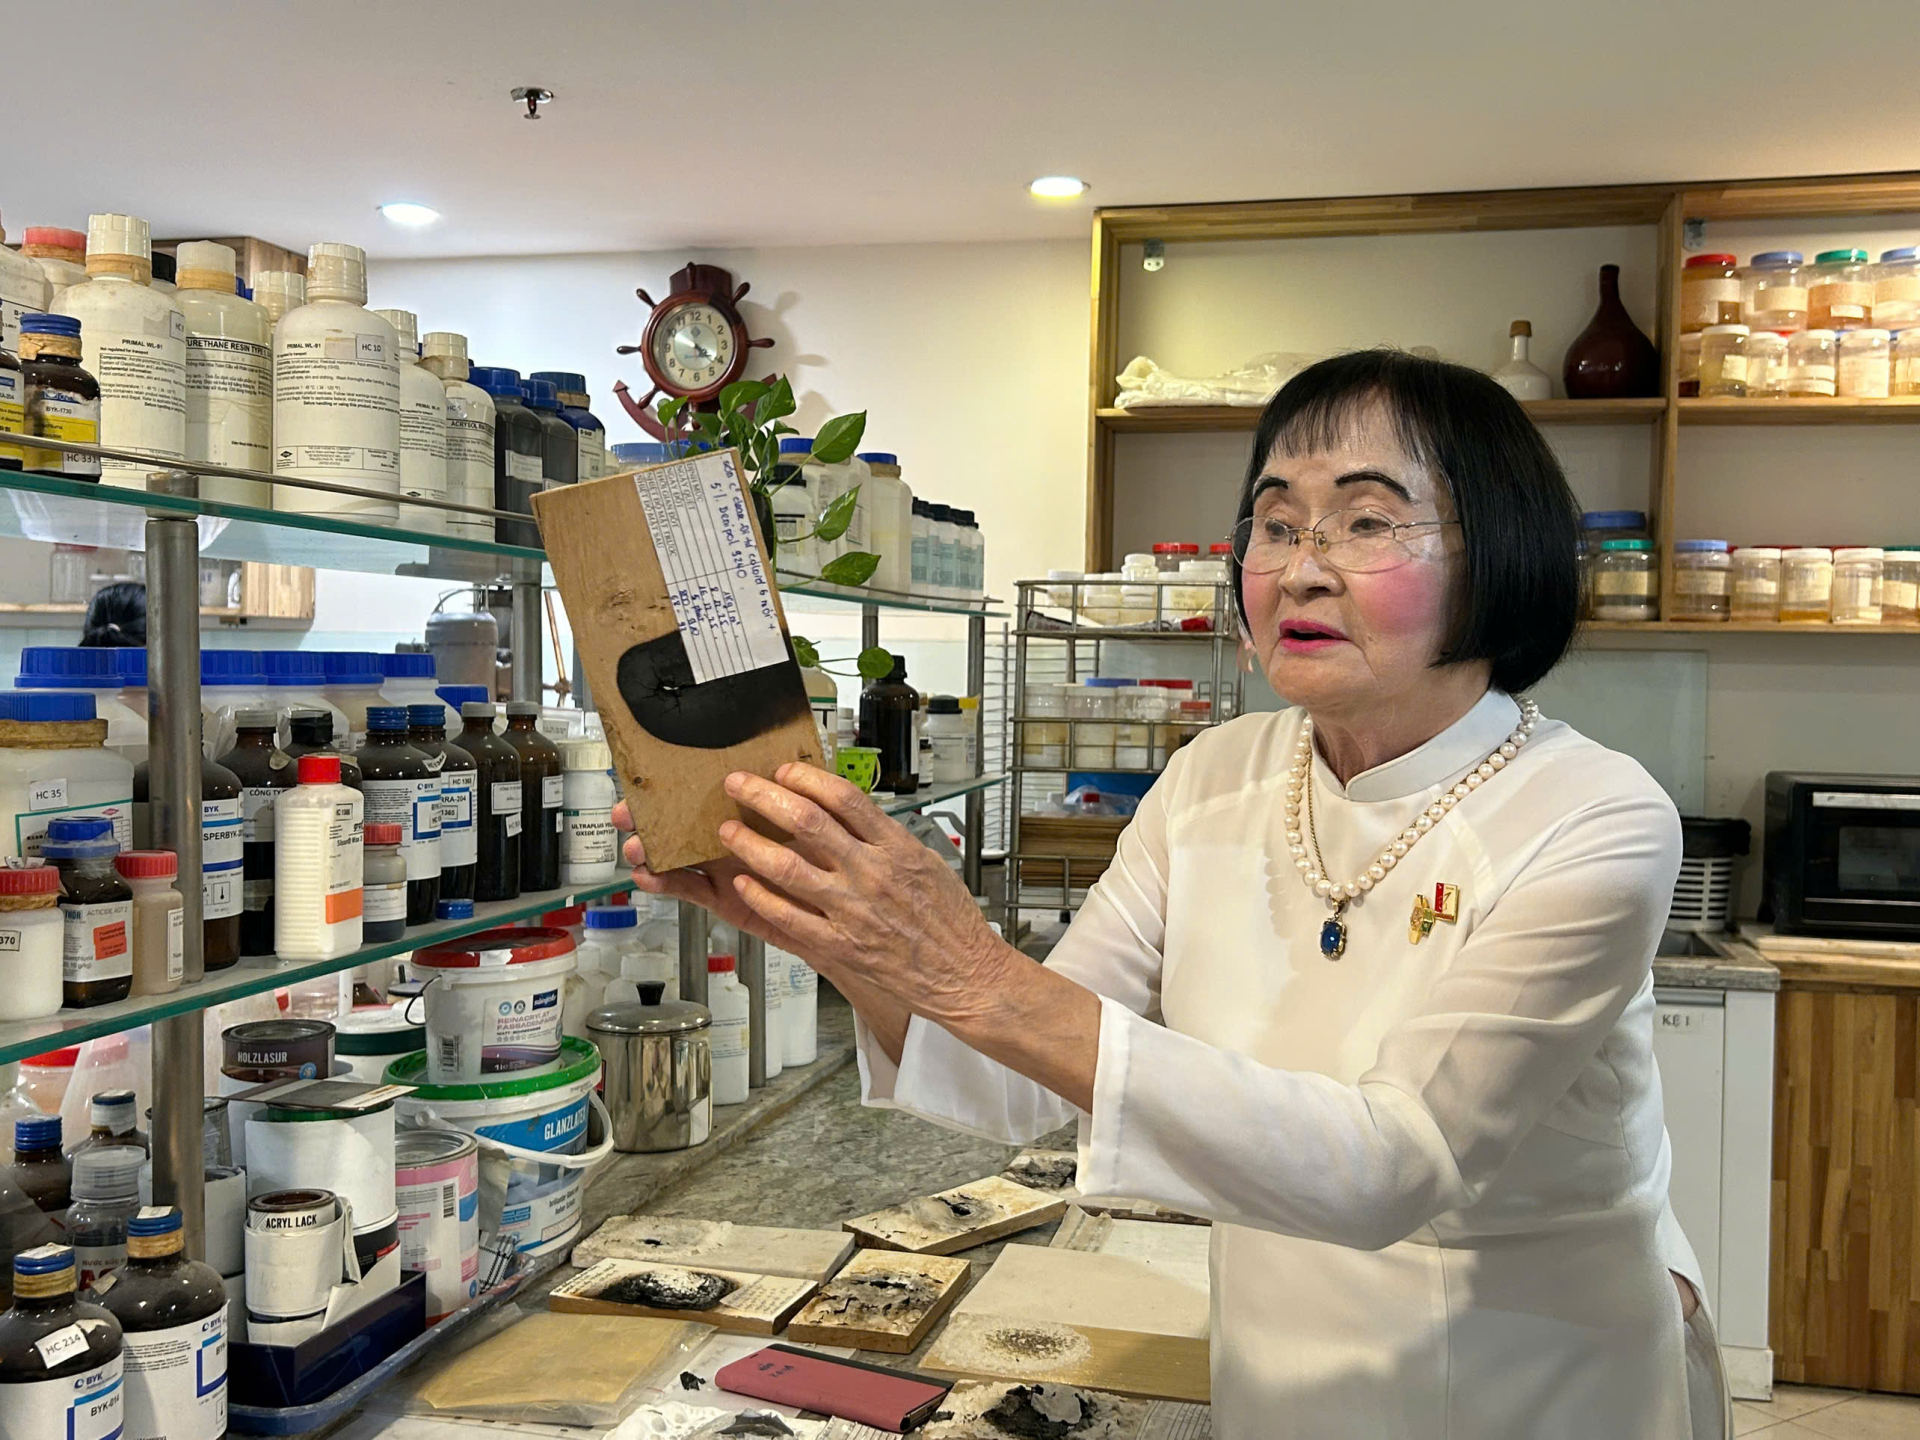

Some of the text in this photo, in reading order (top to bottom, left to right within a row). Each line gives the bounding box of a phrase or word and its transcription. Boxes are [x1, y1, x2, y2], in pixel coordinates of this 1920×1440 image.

[690, 311, 701, 320] 12
[707, 315, 712, 323] 1
[717, 325, 723, 334] 2
[122, 339, 145, 347] PRIMAL
[187, 339, 263, 356] URETHANE RESIN TYPE
[721, 341, 728, 350] 3
[373, 344, 381, 352] 10
[665, 344, 670, 353] 9
[669, 359, 675, 367] 8
[718, 356, 724, 364] 4
[679, 369, 684, 378] 7
[709, 367, 715, 376] 5
[694, 373, 700, 382] 6
[451, 421, 478, 429] ACRYSOL
[67, 454, 96, 463] HC 331
[666, 467, 678, 490] NGÀY
[675, 465, 688, 487] NGÀY
[662, 489, 673, 510] GIAN
[652, 531, 664, 548] SAU
[36, 789, 61, 800] HC 35
[250, 788, 271, 796] CÔNG
[0, 936, 15, 944] 370
[498, 1011, 550, 1024] REINACRYLAT
[238, 1052, 288, 1064] HOLZLASUR
[545, 1105, 586, 1140] GLANZLATEX
[266, 1214, 317, 1229] ACRYL LACK
[211, 1317, 221, 1328] BYK
[45, 1334, 81, 1355] HC 214
[86, 1372, 103, 1385] BYK
